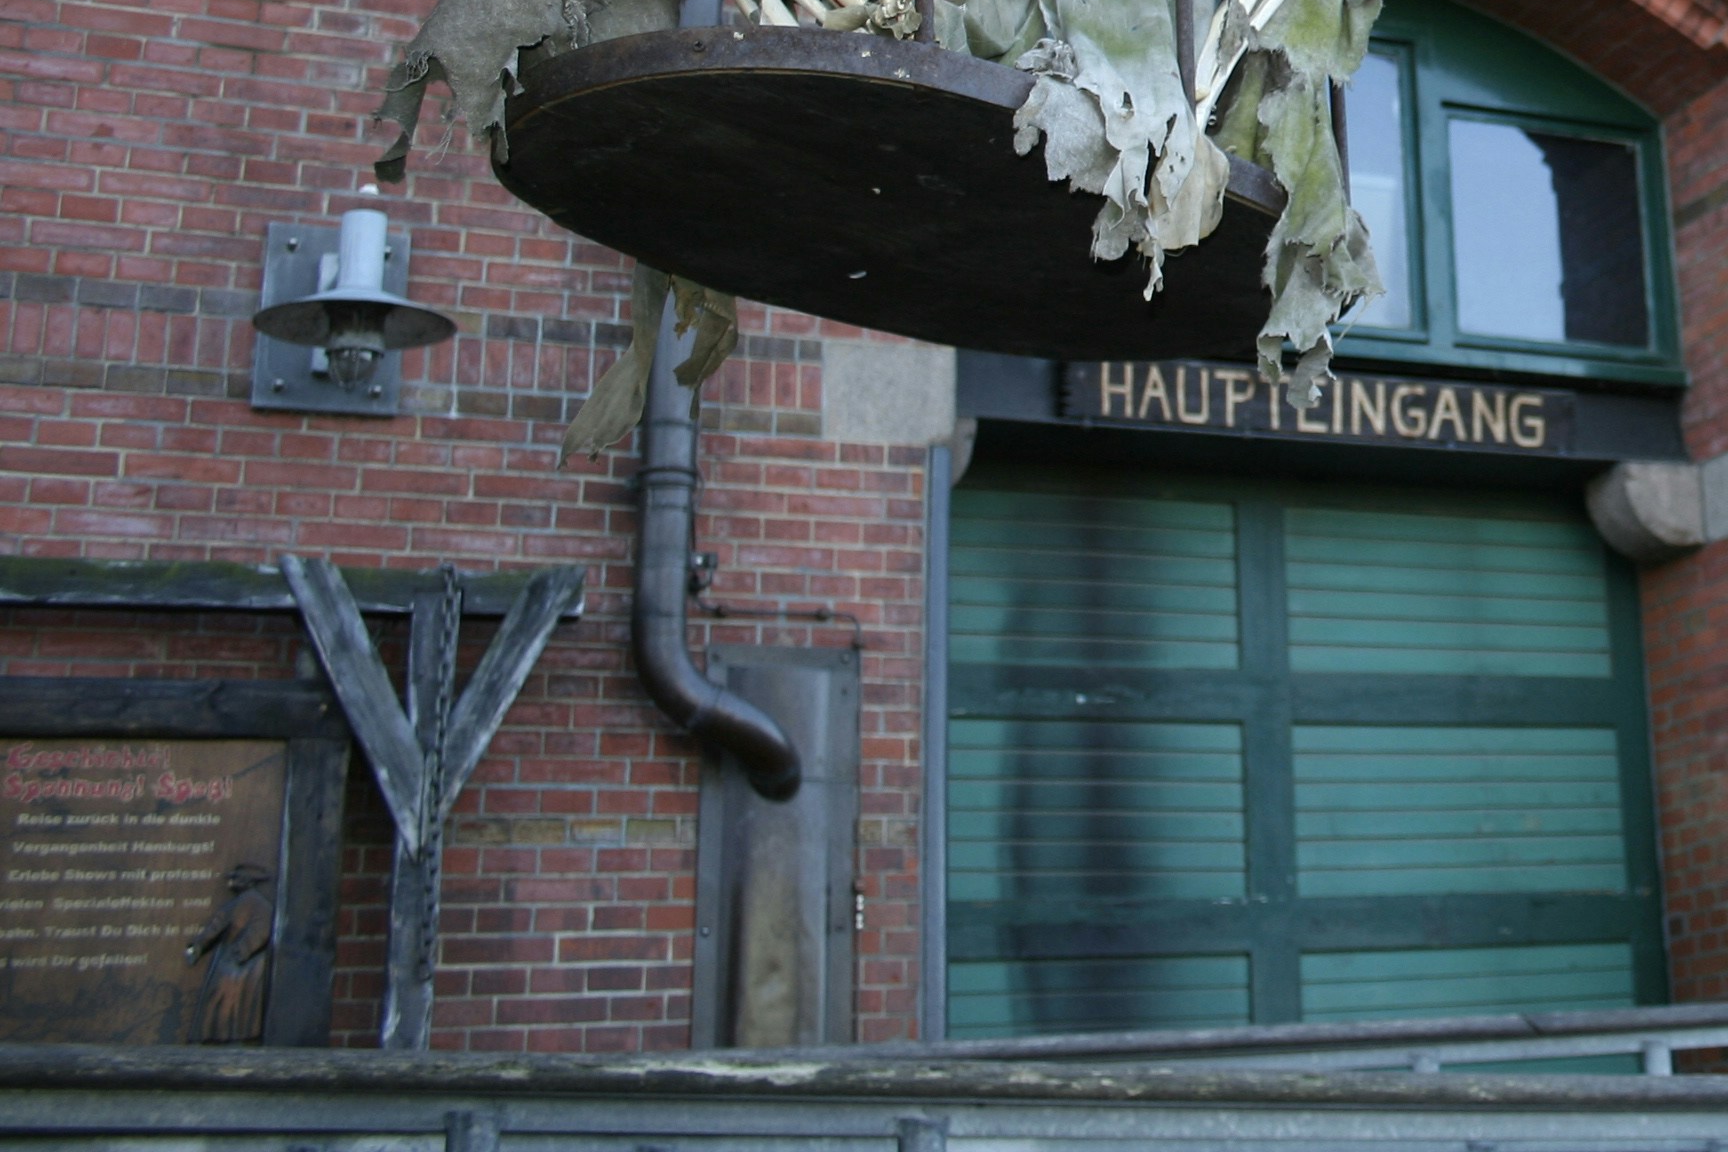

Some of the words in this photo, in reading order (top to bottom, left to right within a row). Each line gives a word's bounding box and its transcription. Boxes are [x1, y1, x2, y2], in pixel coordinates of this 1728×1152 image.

[1101, 360, 1546, 448] HAUPTEINGANG
[3, 771, 146, 803] Spannung!
[154, 769, 233, 804] Spaß!
[17, 812, 62, 825] Reise
[66, 812, 119, 825] zurück
[123, 812, 138, 825] in
[141, 812, 165, 825] die
[169, 812, 221, 825] dunkle
[13, 841, 128, 856] Vergangenheit
[131, 840, 215, 855] Hamburgs!
[8, 869, 60, 881] Erlebe
[63, 868, 117, 881] Shows
[120, 868, 147, 880] mit
[53, 896, 175, 911] Spezialeffekten
[183, 897, 212, 909] und
[45, 925, 97, 938] Traust
[100, 924, 123, 937] Du
[125, 924, 161, 936] Dich
[164, 924, 180, 936] in
[12, 956, 48, 968] wird
[51, 954, 77, 967] Dir
[78, 952, 149, 971] gefallen!
